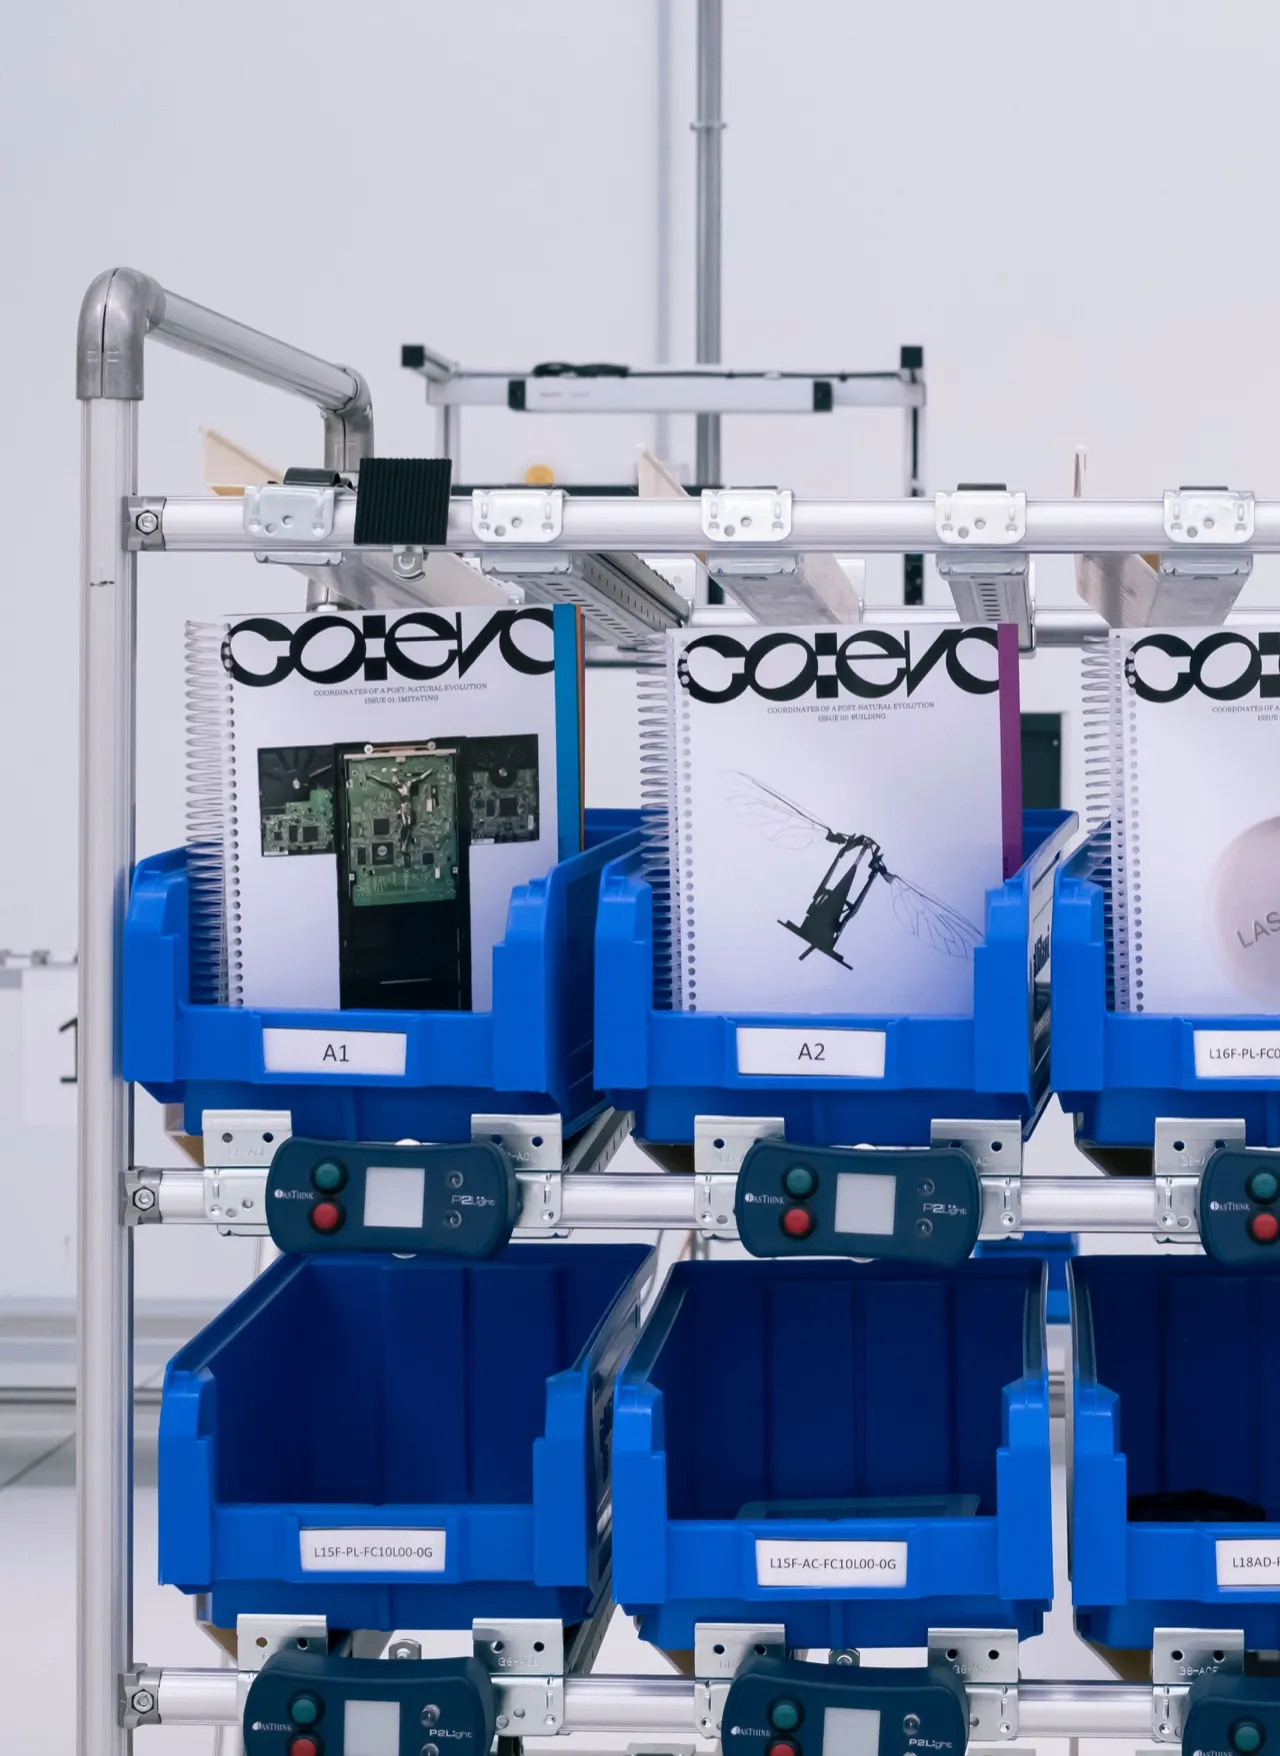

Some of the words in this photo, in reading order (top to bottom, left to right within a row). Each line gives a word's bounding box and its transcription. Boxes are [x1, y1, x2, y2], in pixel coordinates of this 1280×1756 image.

[313, 688, 367, 697] COORDINATES
[444, 683, 488, 692] EVOLUTION
[364, 696, 386, 704] ISSUE
[767, 706, 820, 714] COORDINATES
[821, 705, 831, 713] OF
[893, 701, 935, 710] EVOLUTION
[1212, 705, 1263, 713] COORDINATES
[1257, 713, 1279, 721] ISSUE
[322, 1044, 349, 1062] A1
[797, 1043, 825, 1061] A2
